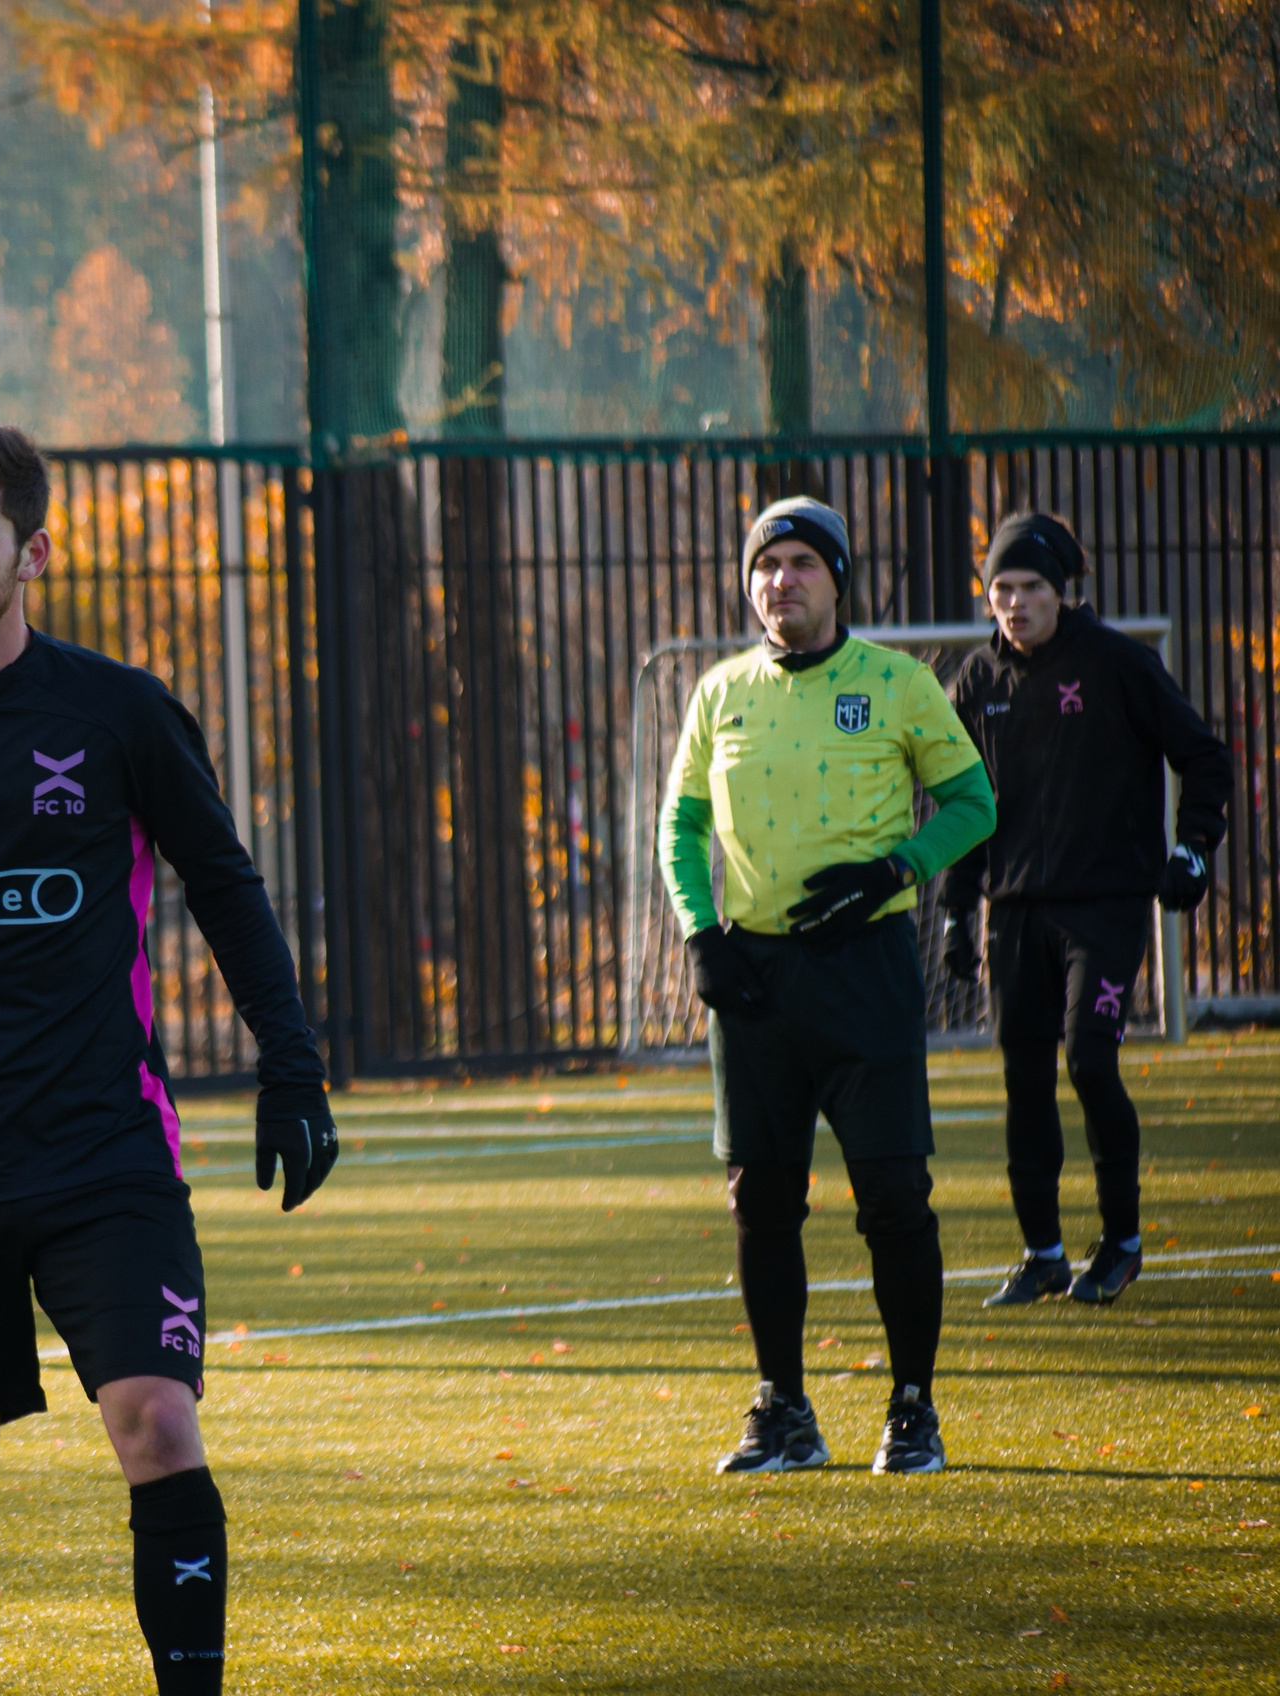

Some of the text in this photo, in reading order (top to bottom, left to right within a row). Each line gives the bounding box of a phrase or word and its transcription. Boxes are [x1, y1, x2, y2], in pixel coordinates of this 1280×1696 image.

[33, 800, 86, 815] FC 10
[162, 1333, 200, 1358] FC 10
